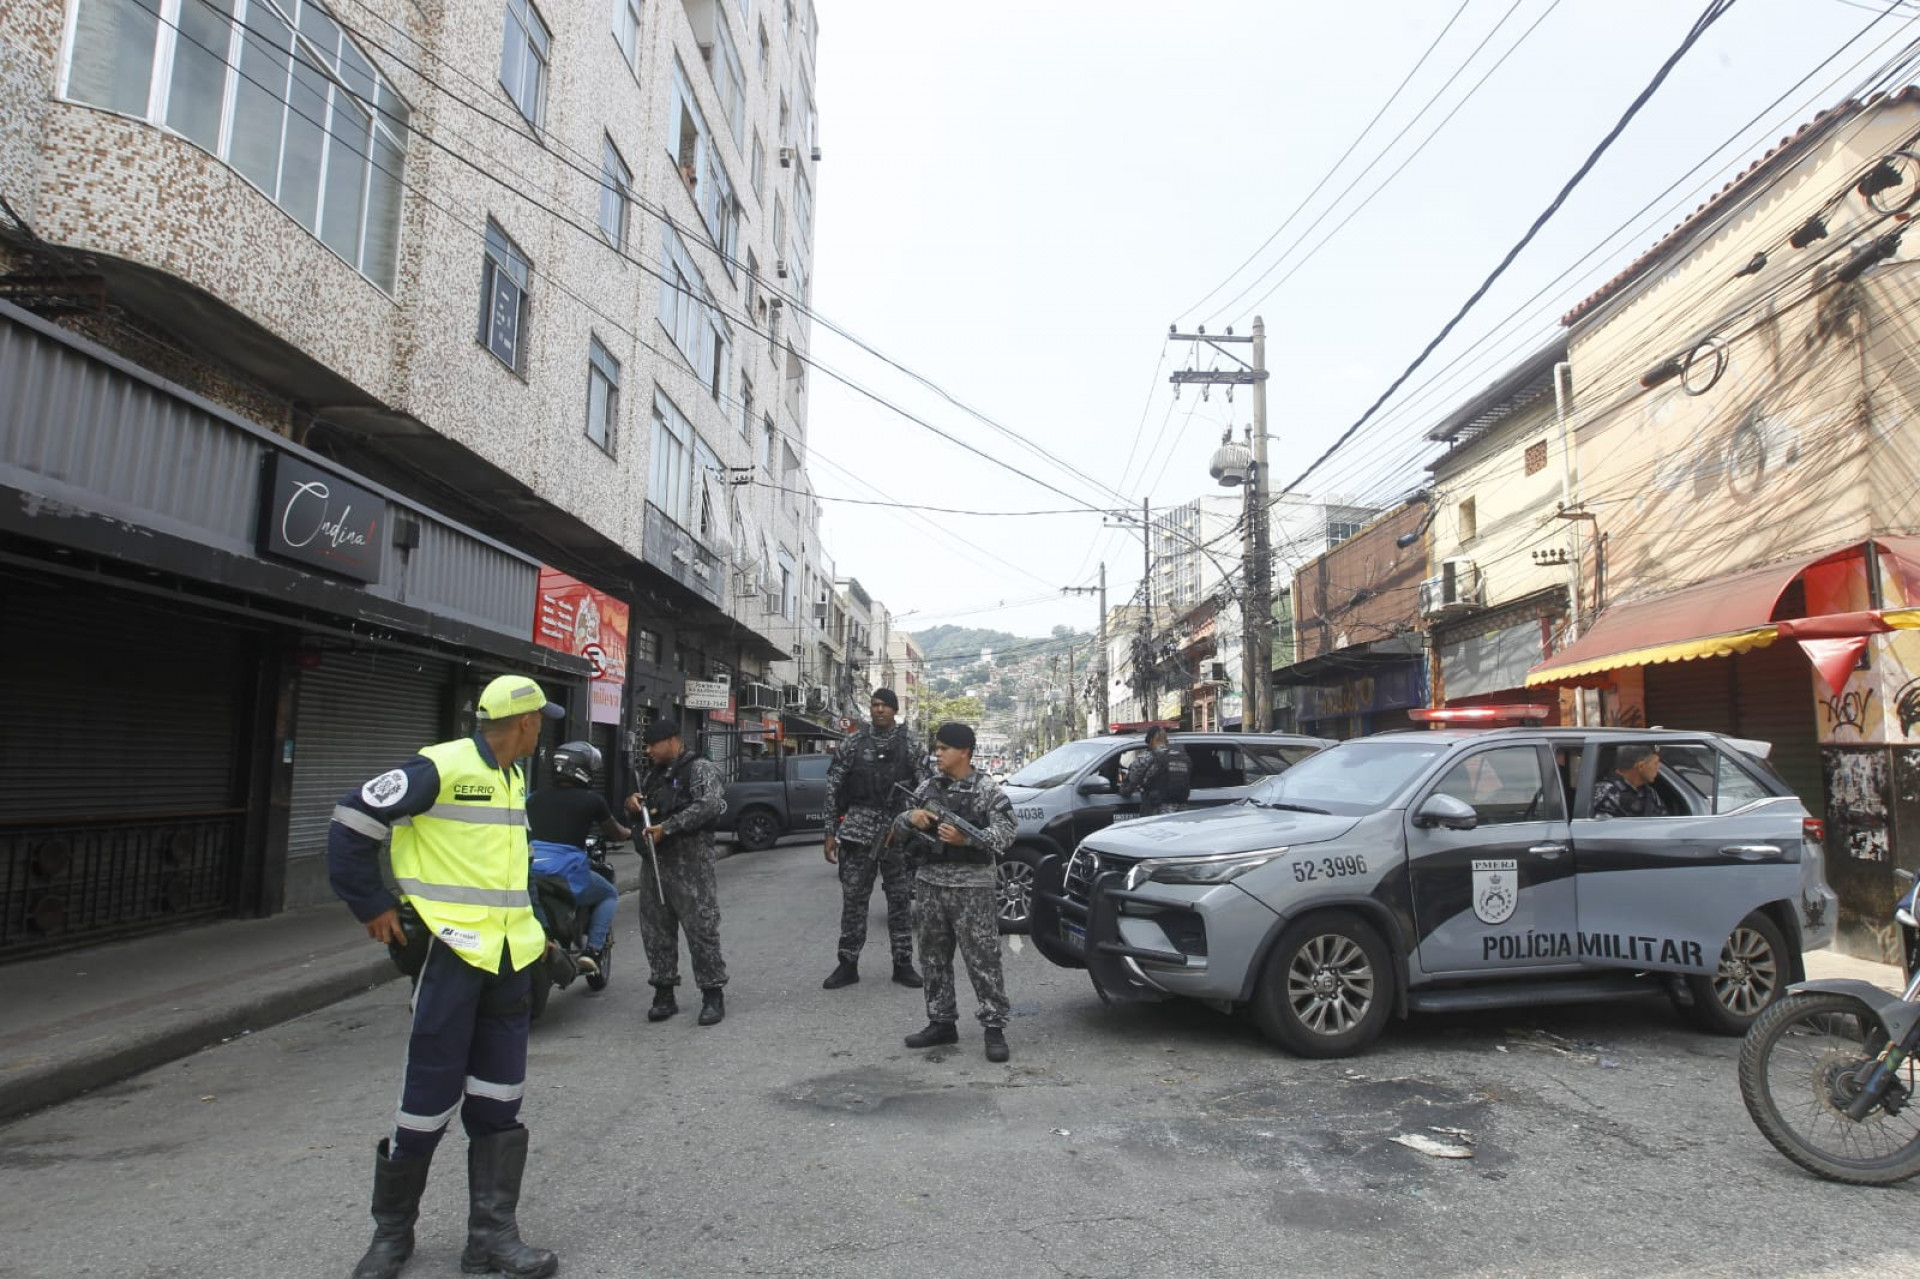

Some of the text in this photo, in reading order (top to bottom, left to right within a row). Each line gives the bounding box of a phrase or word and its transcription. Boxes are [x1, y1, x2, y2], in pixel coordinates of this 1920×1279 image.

[453, 784, 495, 794] CET-RIO
[1292, 854, 1368, 882] 52-3996
[1475, 861, 1515, 869] PMERJ
[1482, 929, 1703, 967] POLÍCIA MILITAR
